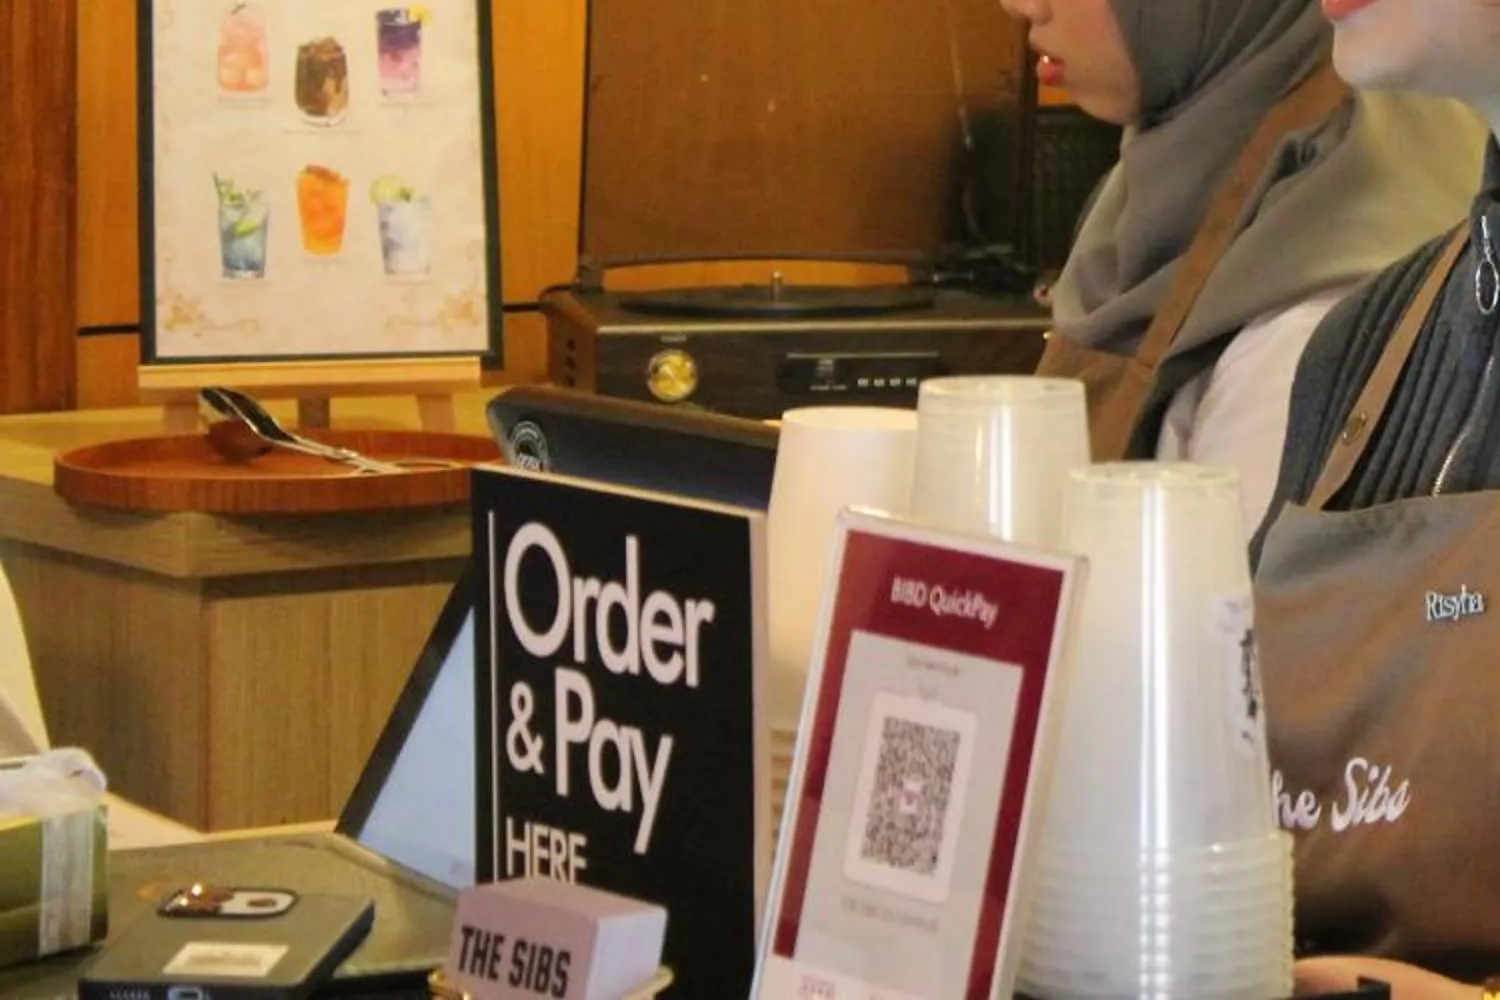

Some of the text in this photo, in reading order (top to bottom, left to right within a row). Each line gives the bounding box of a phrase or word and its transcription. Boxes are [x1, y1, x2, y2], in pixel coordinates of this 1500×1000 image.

[504, 521, 715, 687] Order
[929, 584, 999, 631] QuickPay
[505, 668, 673, 855] & Pay
[1272, 757, 1411, 832] he Sibs
[458, 925, 571, 998] THE SIBS
